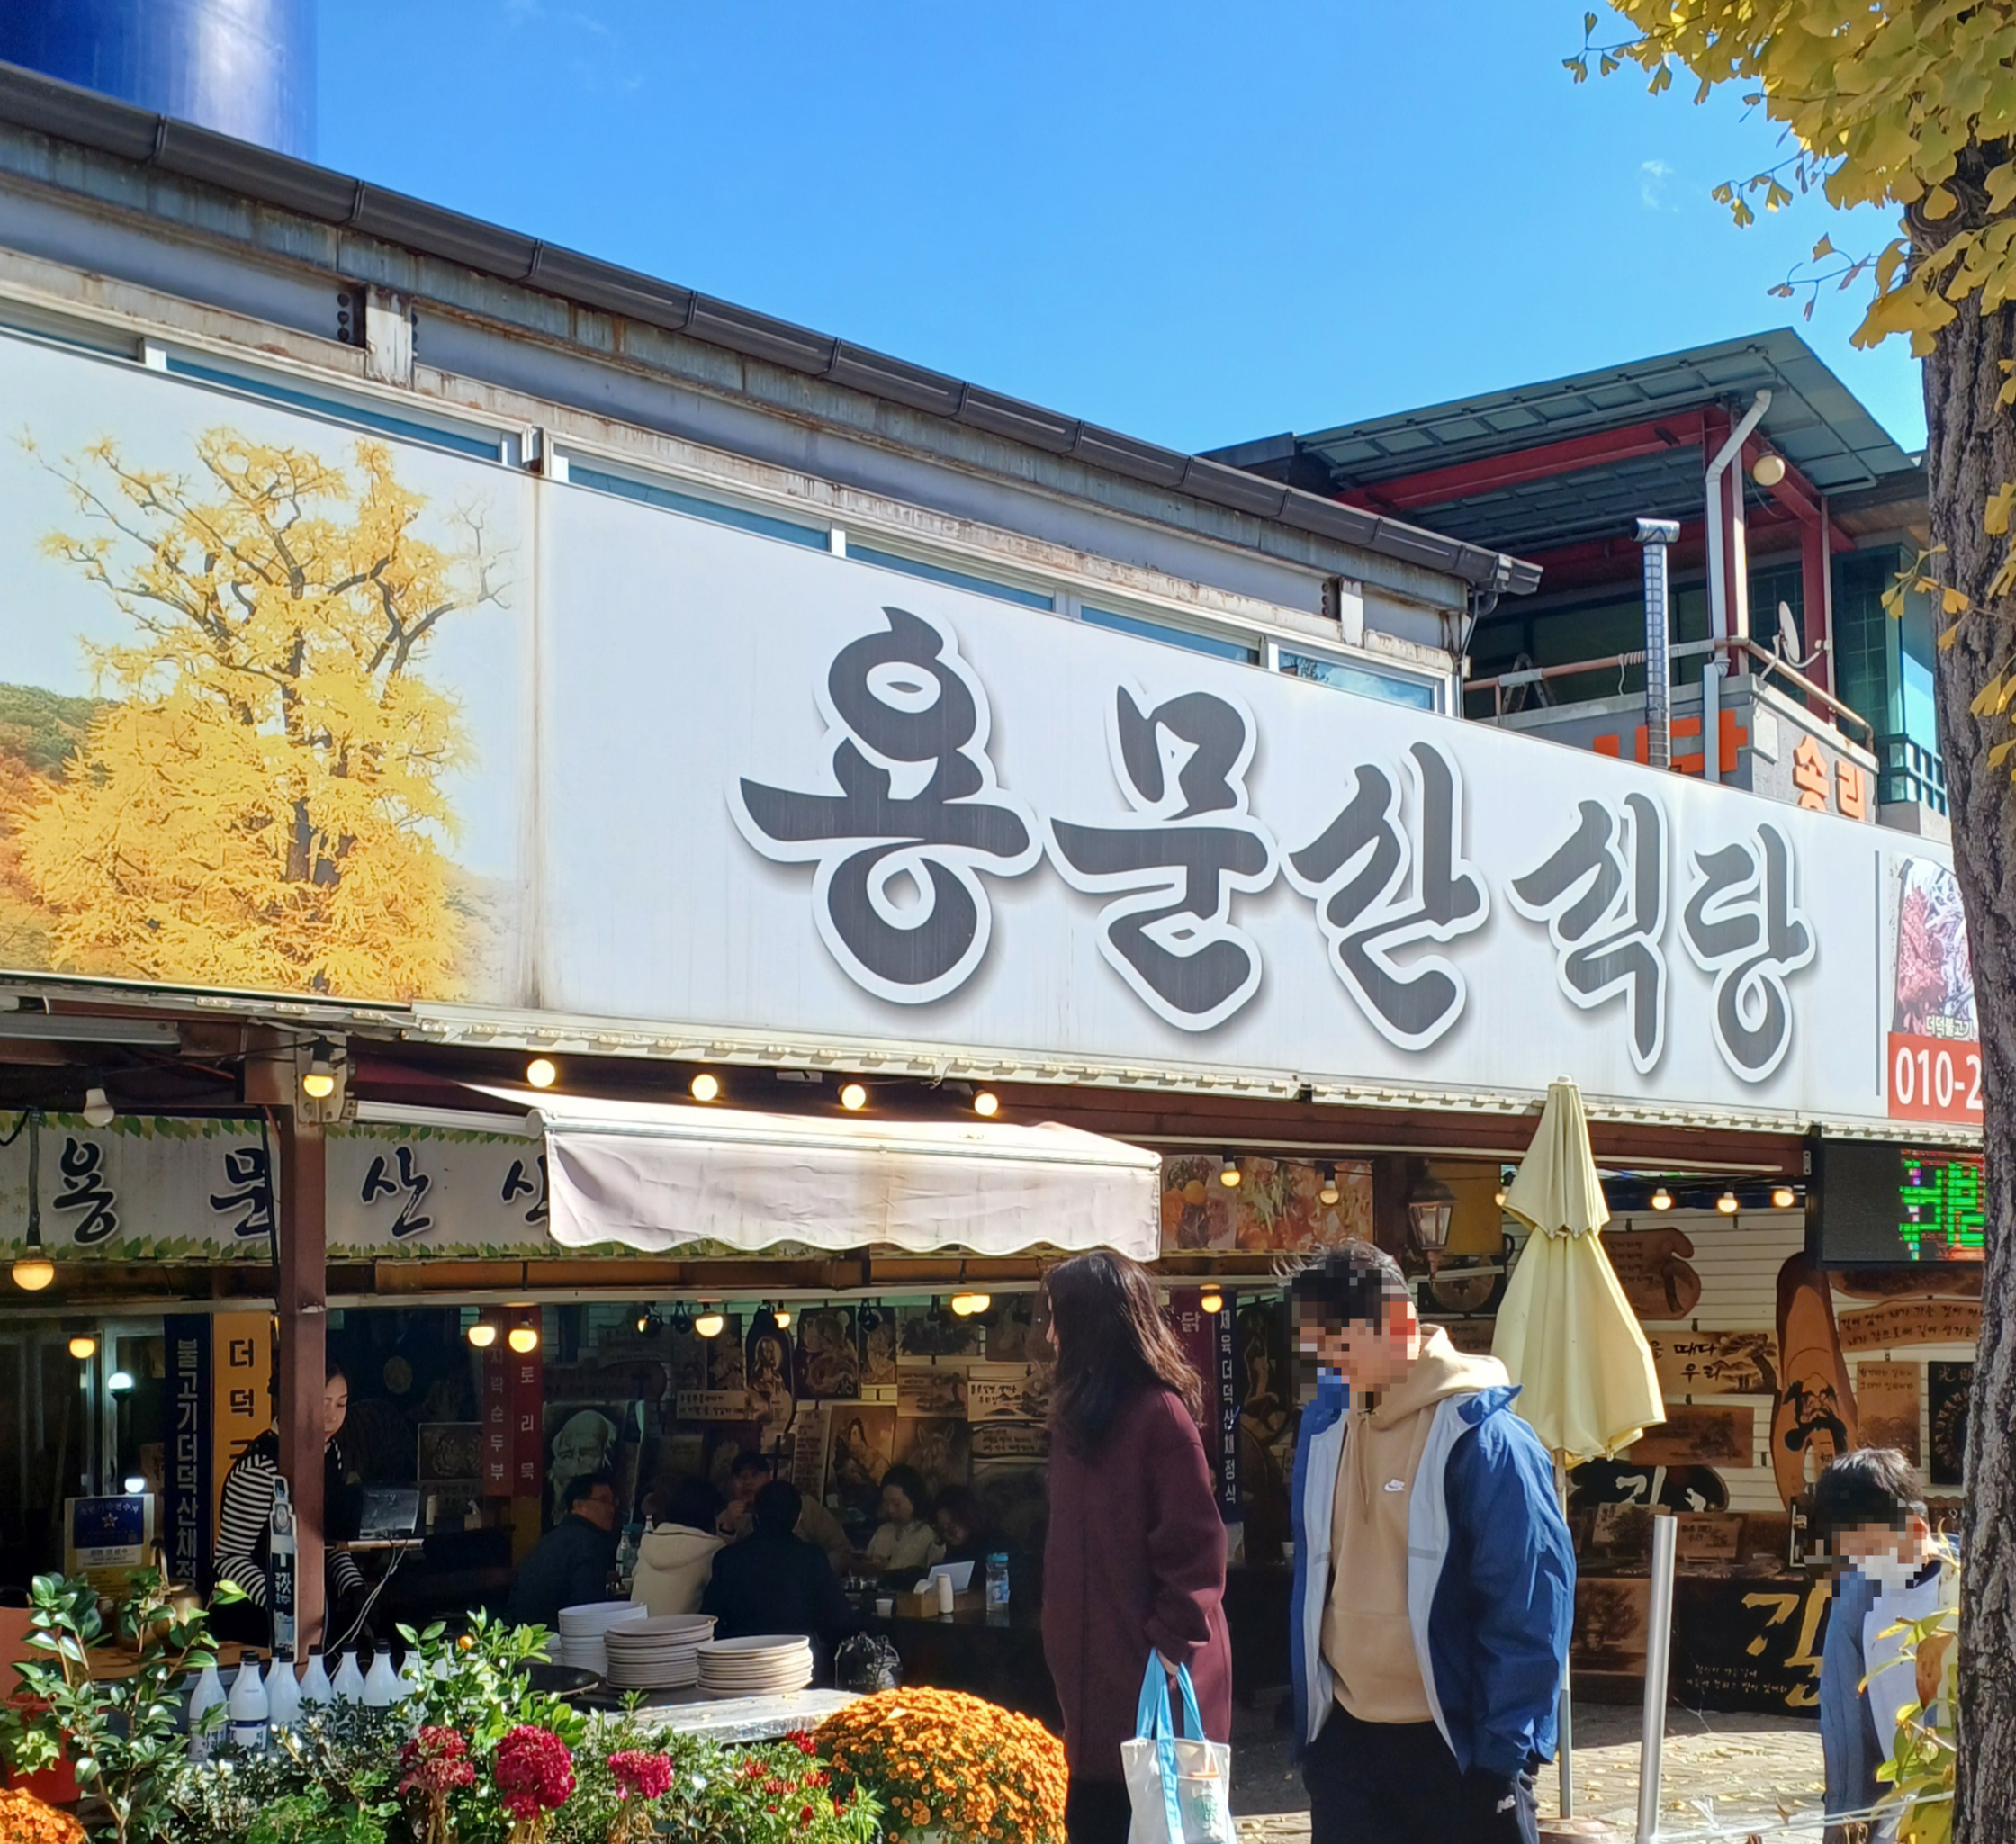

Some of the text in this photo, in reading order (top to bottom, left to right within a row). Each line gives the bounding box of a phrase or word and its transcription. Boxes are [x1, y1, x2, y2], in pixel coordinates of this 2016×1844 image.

[736, 603, 1813, 1071] 용문산식당
[1926, 1014, 1974, 1039] 더덕불고기
[1894, 1046, 1984, 1111] 010-2
[1180, 1310, 1202, 1333] 닭
[1680, 1363, 1721, 1383] 우리
[1220, 1309, 1237, 1505] 제육더덕산채정식
